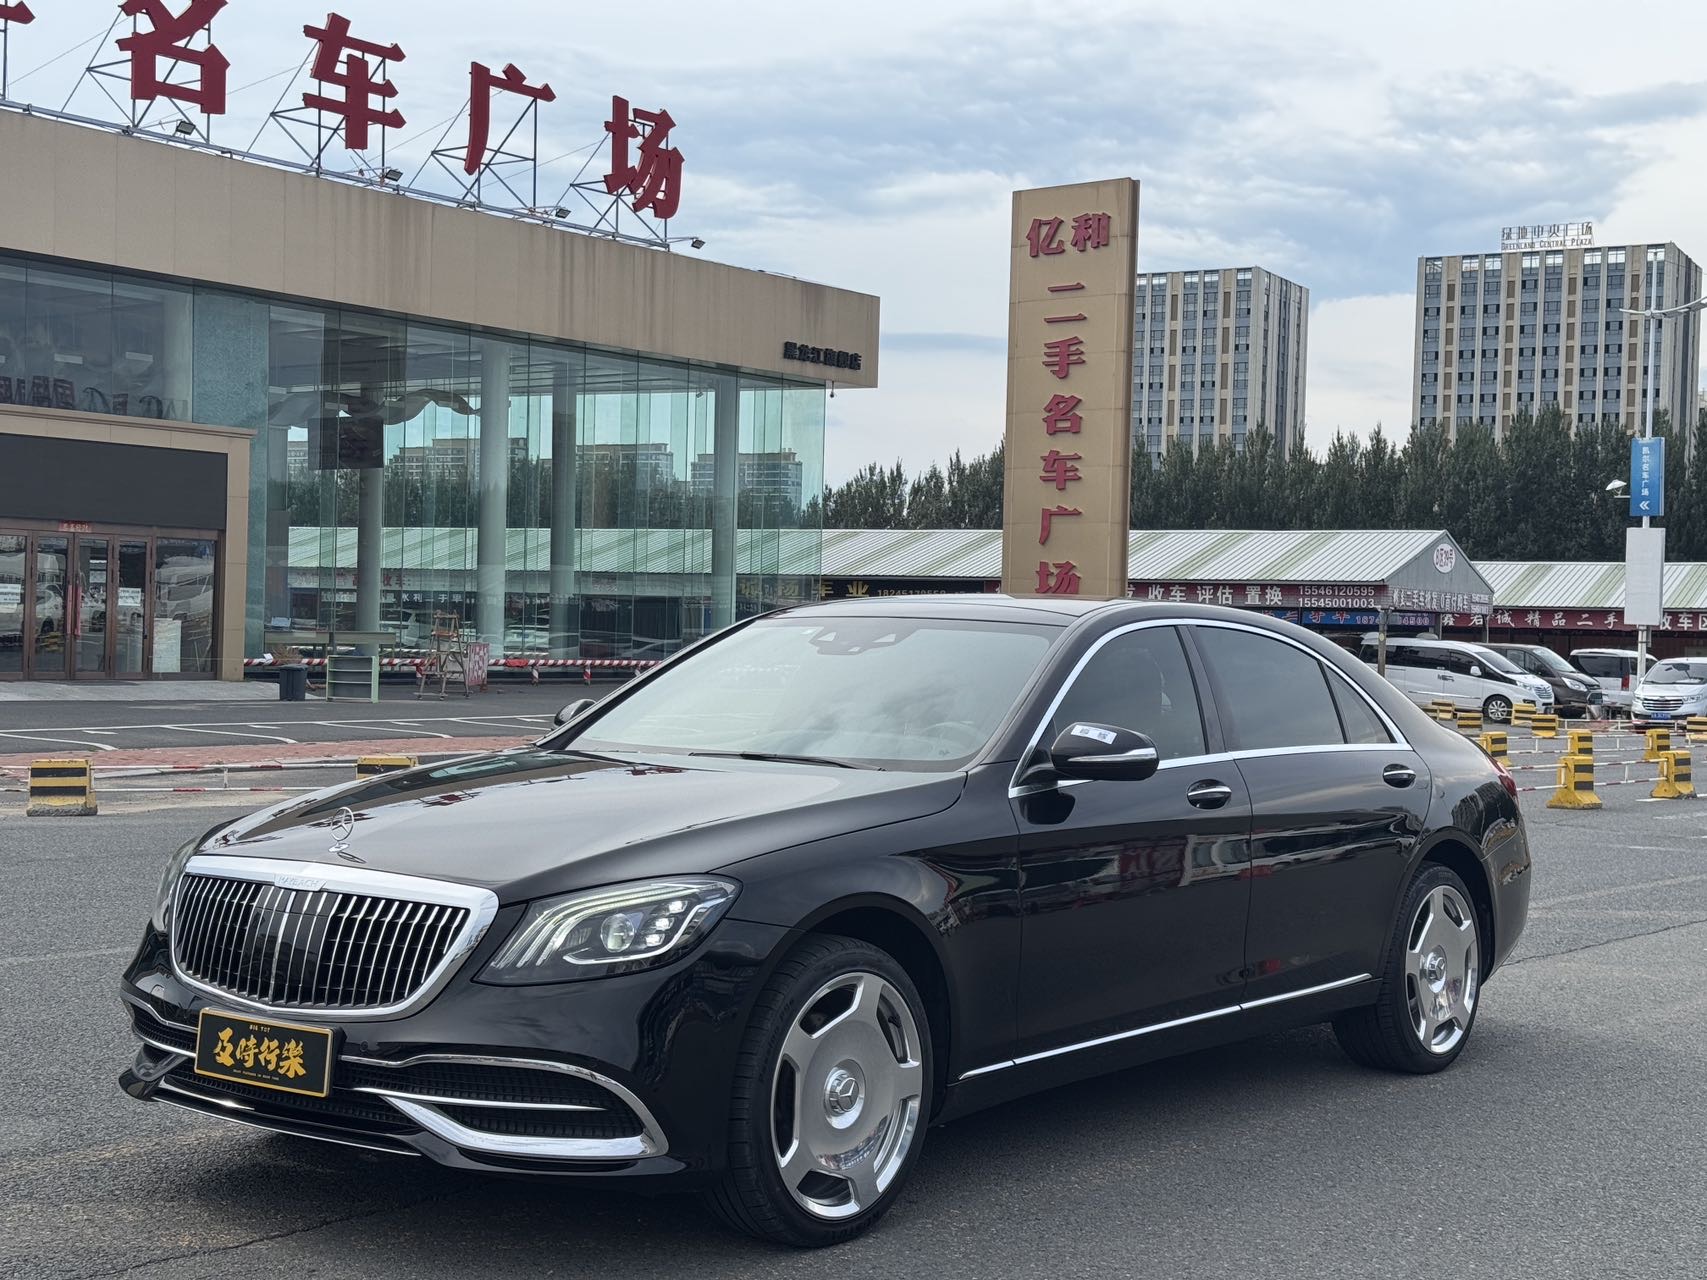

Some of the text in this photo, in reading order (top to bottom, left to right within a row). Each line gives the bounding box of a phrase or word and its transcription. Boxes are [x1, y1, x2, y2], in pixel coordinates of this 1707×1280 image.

[0, 0, 684, 220] 名车广场
[1026, 211, 1111, 257] 亿和
[1501, 222, 1593, 240] 绿地中央广场
[1035, 282, 1087, 594] 二手名车广场
[1148, 585, 1186, 601] 收车
[1196, 585, 1233, 605] 评估
[1245, 586, 1283, 605] 置换
[1298, 597, 1375, 609] 15545001003
